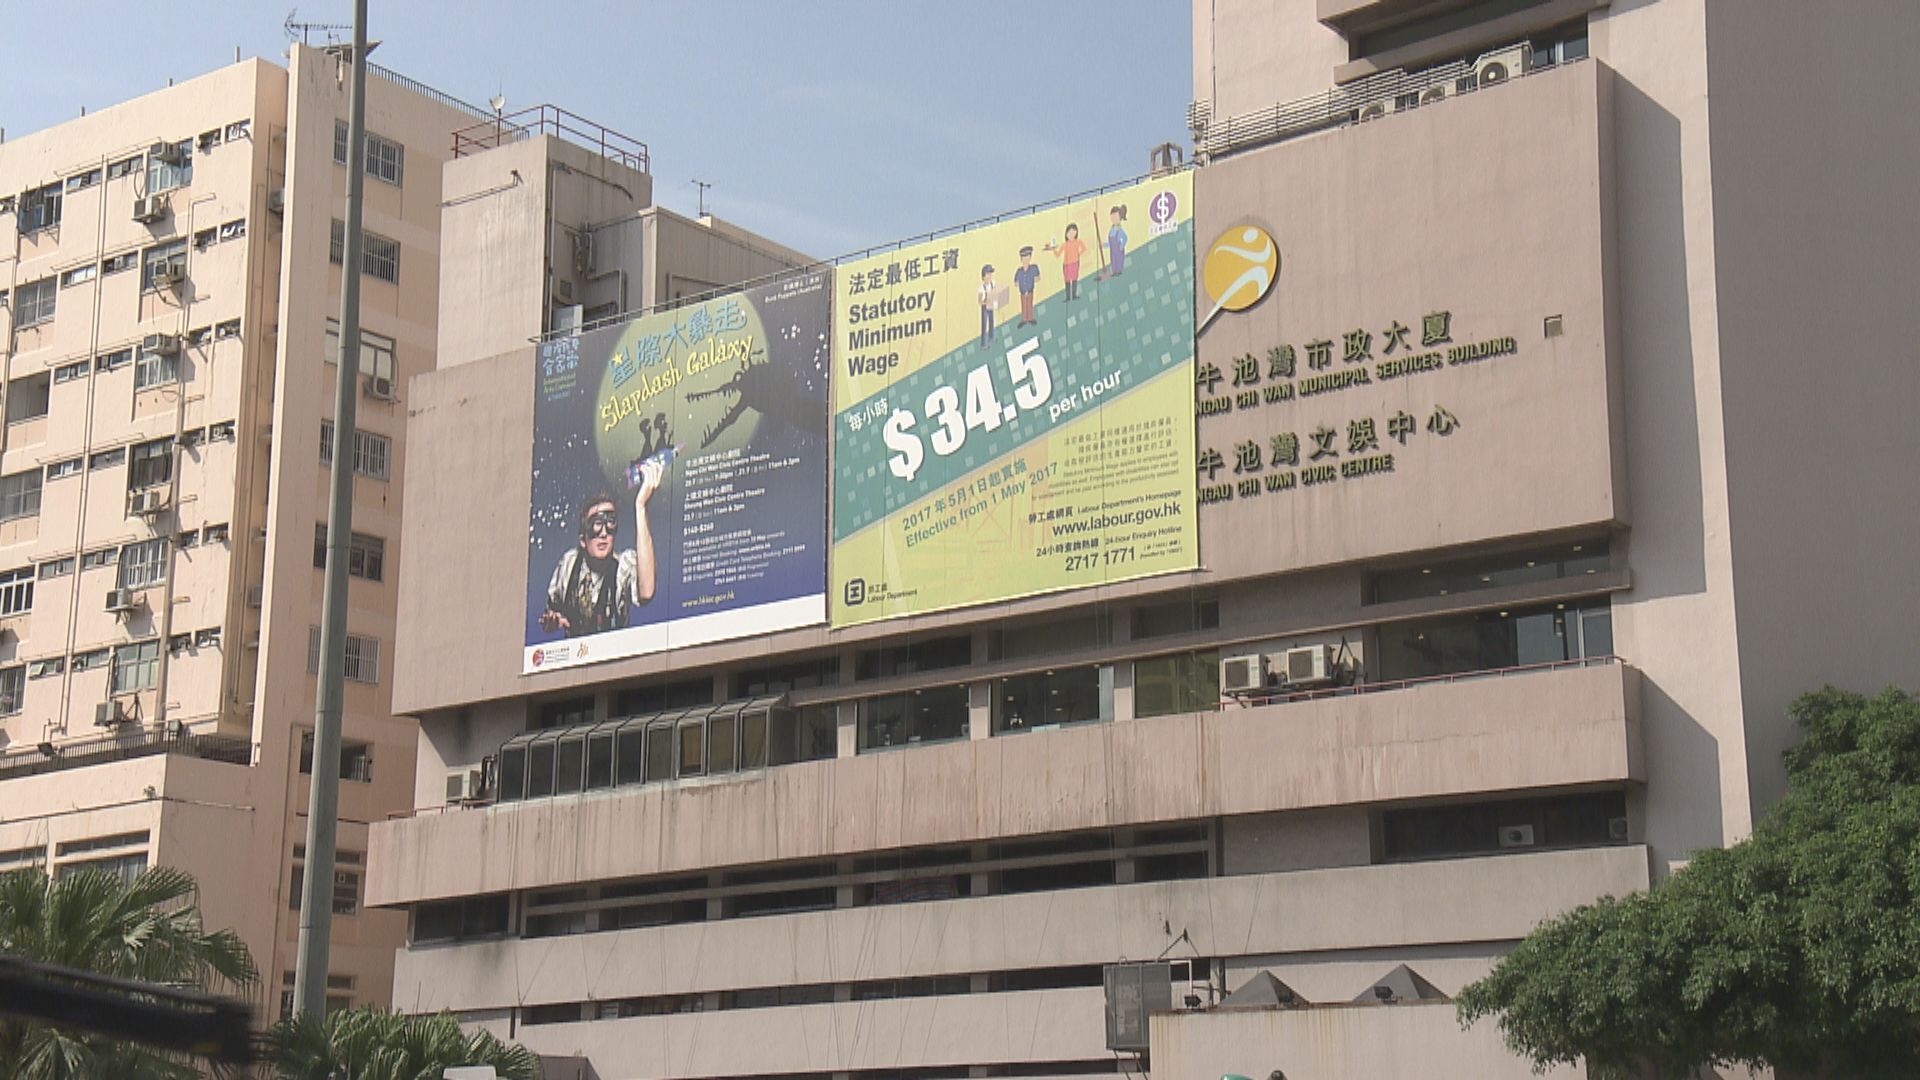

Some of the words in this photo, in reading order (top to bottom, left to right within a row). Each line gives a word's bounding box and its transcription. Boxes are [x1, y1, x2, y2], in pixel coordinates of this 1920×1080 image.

[849, 248, 959, 295] 法定最低工資
[849, 290, 935, 324] Statutory
[608, 300, 747, 389] 星際大暴走
[849, 318, 932, 351] Minimum
[1196, 311, 1452, 393] 牛池灣市政大廈
[600, 357, 683, 432] Slapdash
[686, 335, 753, 376] Galaxy
[848, 352, 899, 377] Wage
[1236, 391, 1258, 409] CHI
[1263, 383, 1294, 404] WAN
[1297, 367, 1369, 397] MUNICIPAL
[1376, 351, 1442, 380] SERVICES
[1448, 336, 1516, 365] BUILDING
[849, 396, 888, 432] 每小時
[882, 336, 1052, 481] $34.5
[1049, 393, 1077, 422] per
[1081, 368, 1122, 403] hour
[1197, 404, 1460, 480] 牛池灣文娛中心
[1237, 479, 1260, 497] CHI
[1265, 472, 1296, 491] WAN
[1301, 465, 1337, 486] CIVIC
[1341, 454, 1394, 478] CENTRE
[905, 513, 957, 548] Effective
[959, 499, 988, 522] from
[991, 493, 997, 505] 1
[1001, 480, 1026, 501] May
[1029, 462, 1058, 486] 2017
[1052, 501, 1181, 536] www.labour.gov.hk
[1077, 504, 1099, 515] Labour
[1101, 495, 1144, 511] Department's
[1145, 489, 1181, 503] Homepage
[1158, 525, 1182, 536] Hotline
[1065, 553, 1099, 571] 2717
[1102, 546, 1136, 566] 1771
